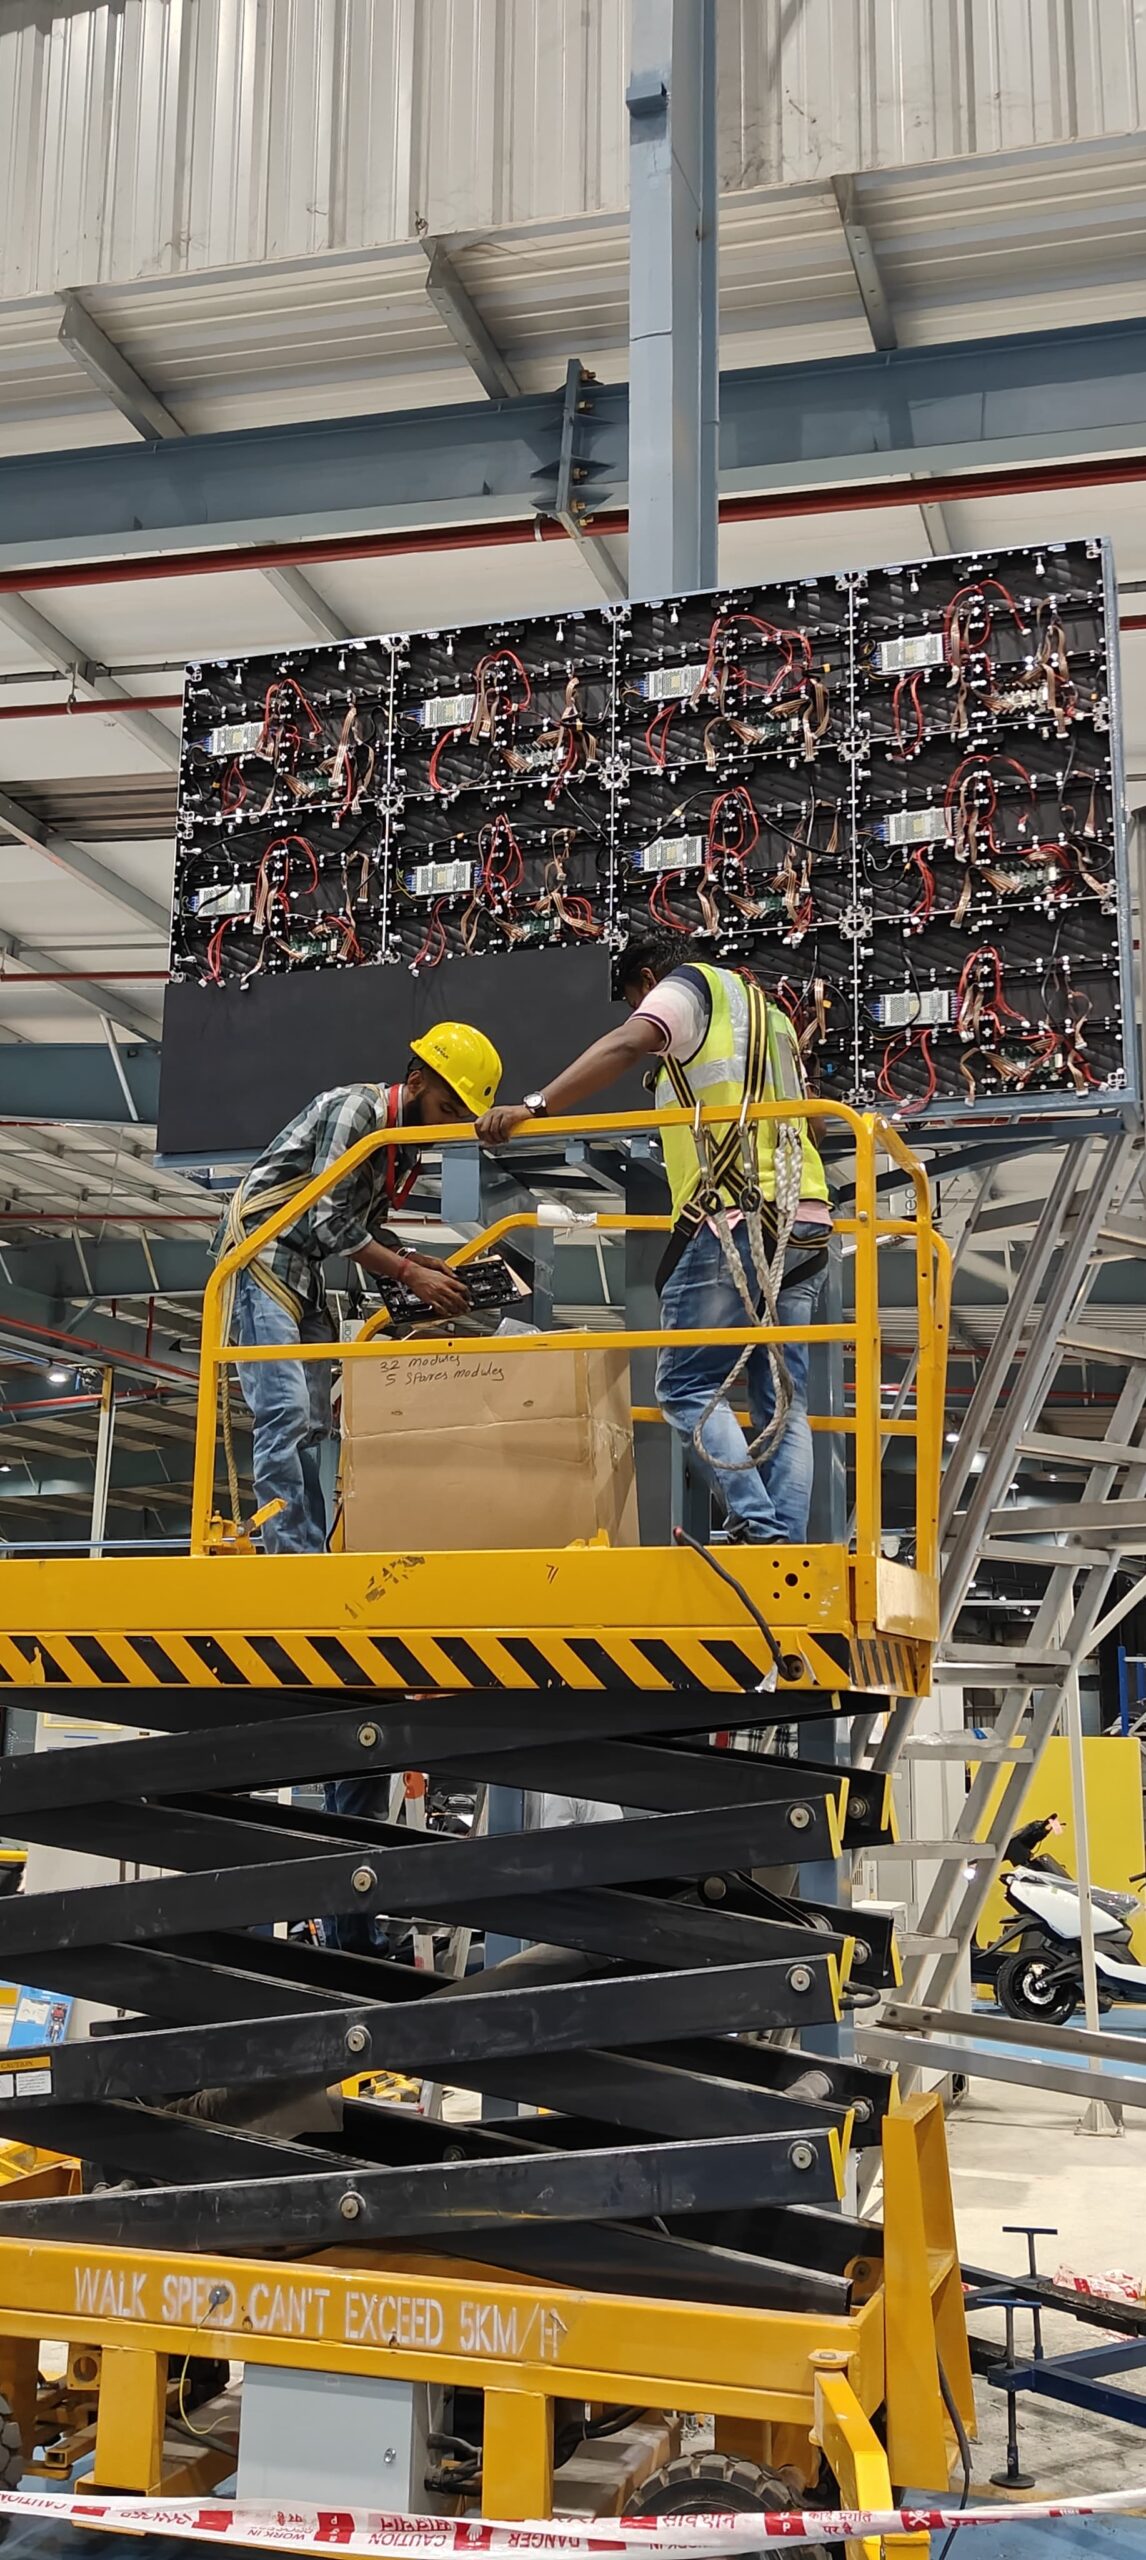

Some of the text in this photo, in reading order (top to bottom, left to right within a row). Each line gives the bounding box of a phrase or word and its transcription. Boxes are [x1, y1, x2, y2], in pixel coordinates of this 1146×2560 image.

[380, 1360, 400, 1372] 32
[385, 1374, 396, 1386] 5
[75, 2266, 147, 2319] WALK
[249, 2283, 331, 2335] CAN'T
[345, 2291, 443, 2346] EXCEED
[460, 2300, 561, 2358] 5KM/H
[264, 2530, 305, 2540] WORK
[368, 2533, 447, 2547] CAUTION
